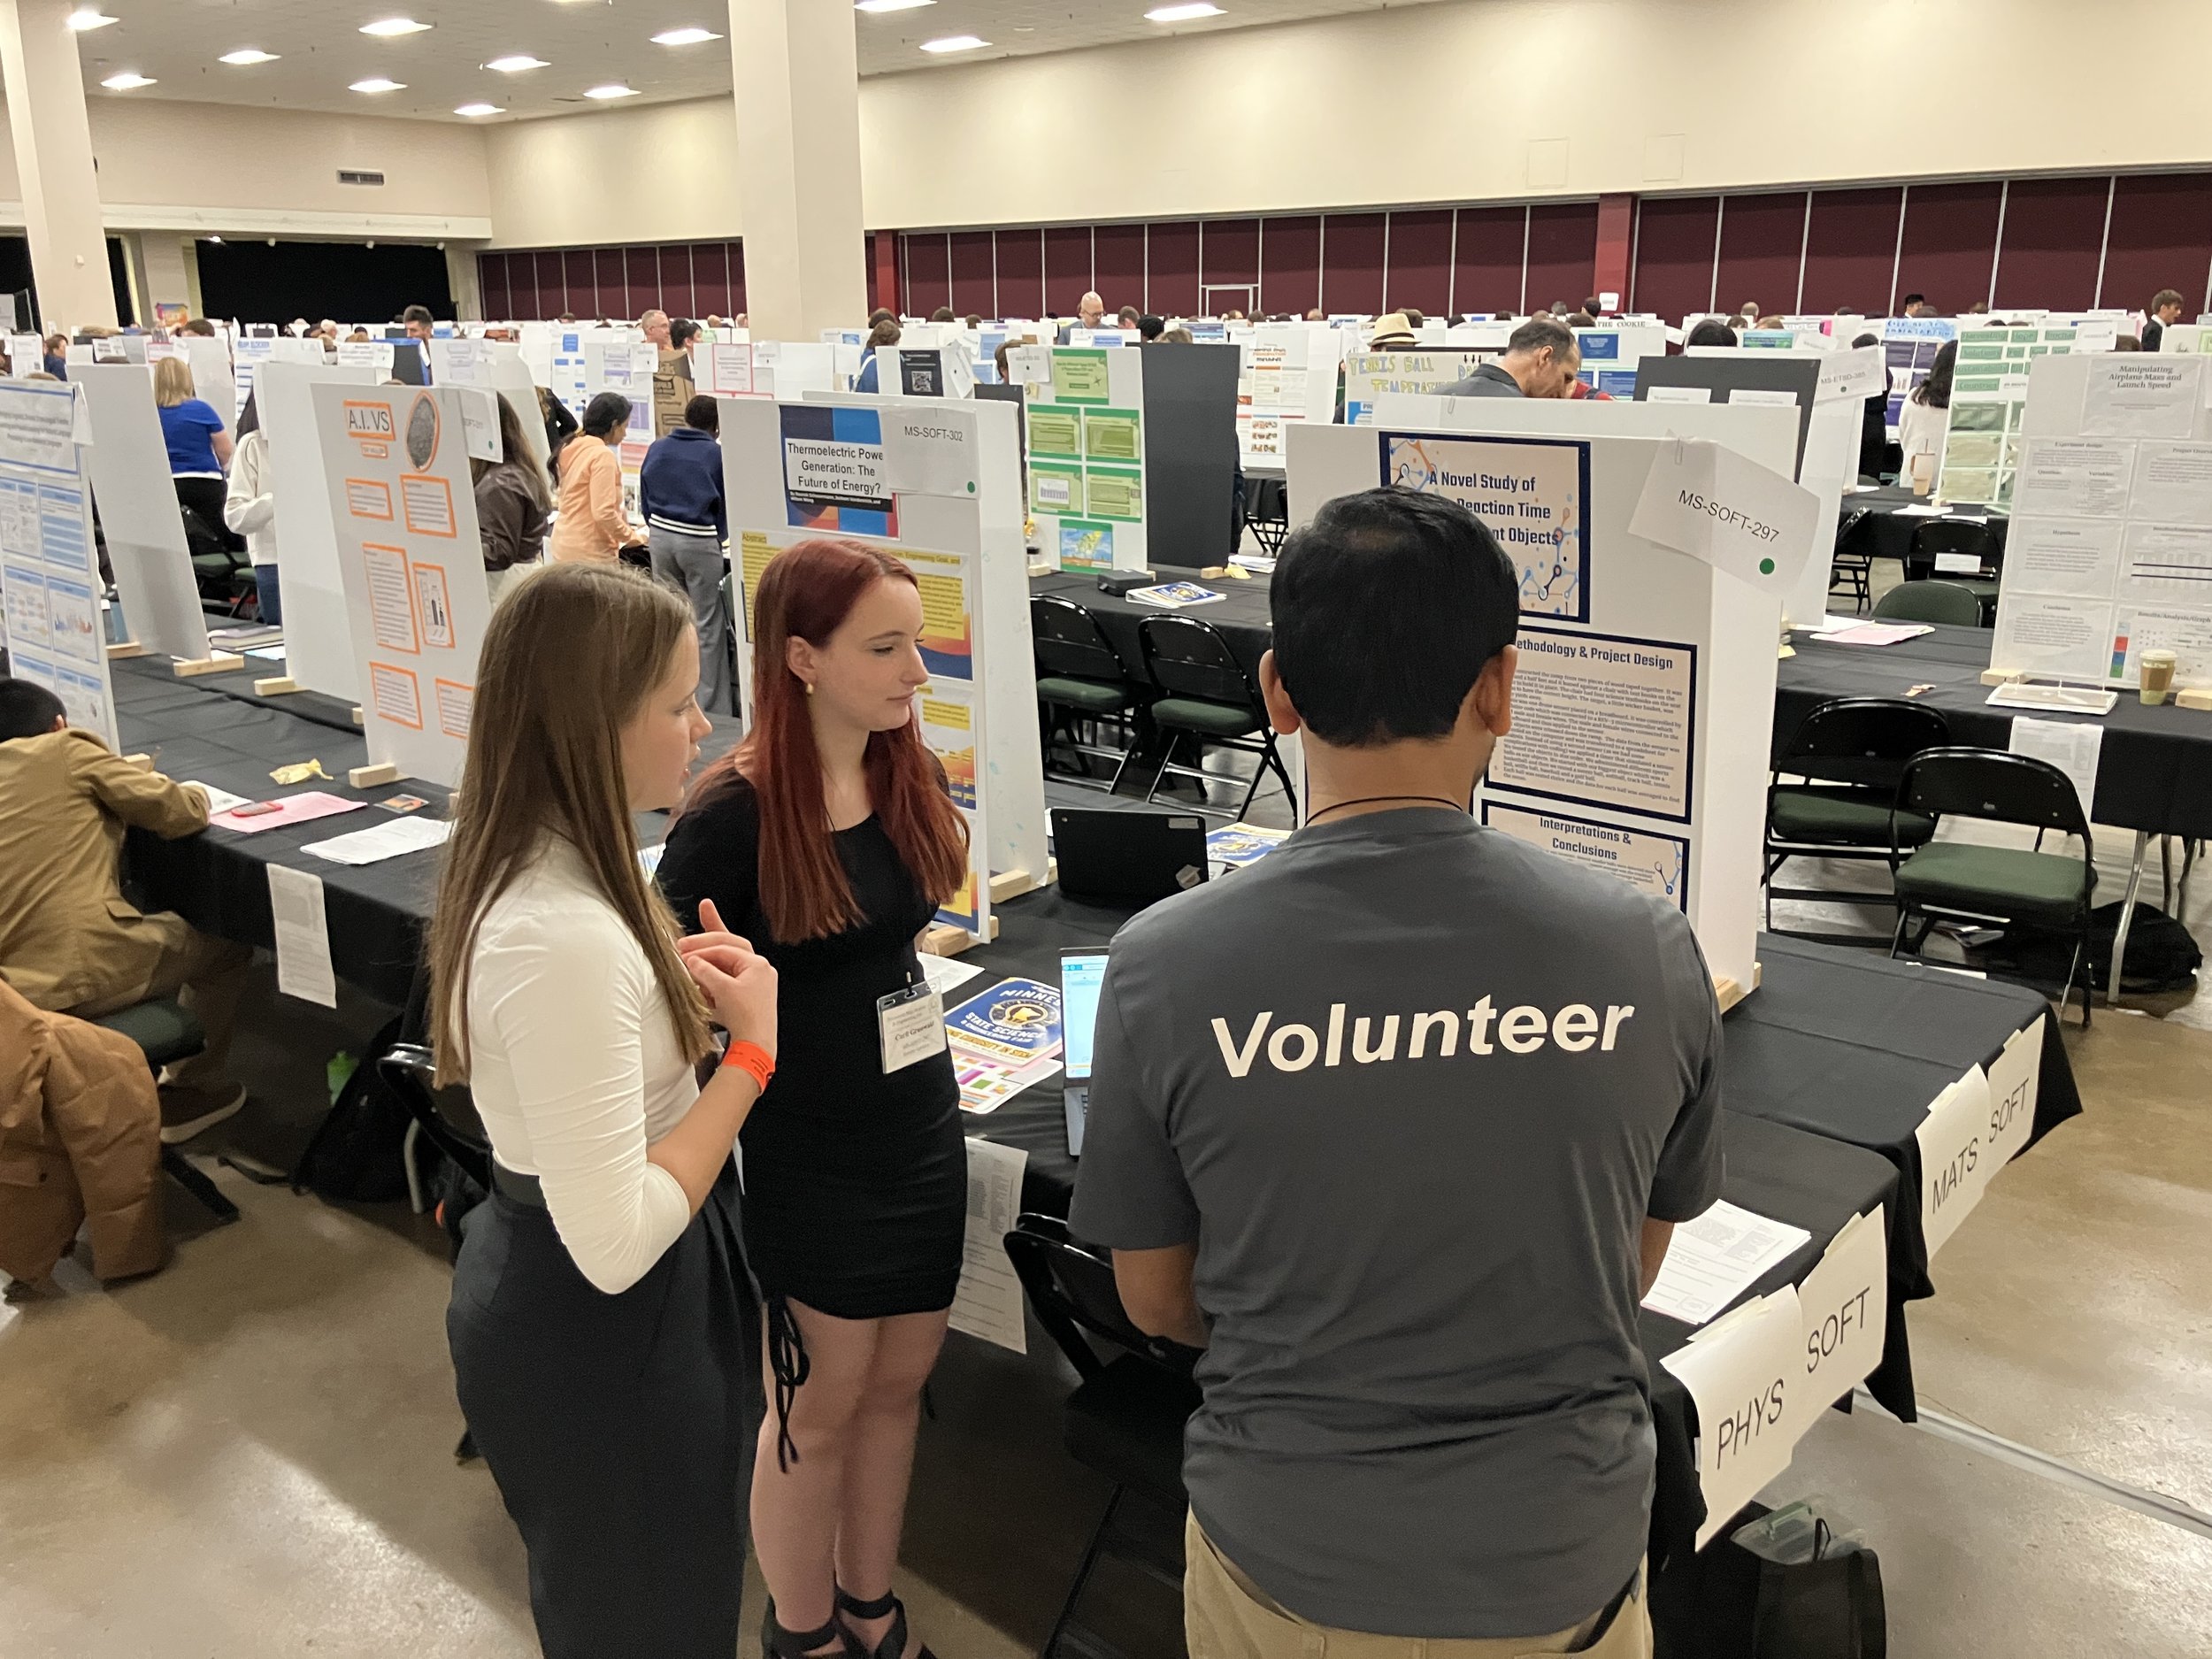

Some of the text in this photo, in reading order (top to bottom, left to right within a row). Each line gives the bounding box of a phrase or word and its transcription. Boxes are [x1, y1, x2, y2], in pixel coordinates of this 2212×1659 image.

[1349, 355, 1434, 375] TENNIS BALL
[2119, 365, 2173, 374] Manipulating
[1371, 379, 1440, 395] TEMPERAT
[349, 410, 390, 432] A.I. VS
[904, 426, 963, 442] MS-SOFT-302
[787, 443, 883, 460] Thermoelectric Powe
[802, 461, 875, 476] Generation: The
[798, 476, 881, 495] Future of Energy?
[1428, 472, 1536, 492] A Novel Study of
[1518, 502, 1551, 518] Time
[1678, 490, 1780, 543] MS-SOFT-297
[1509, 527, 1559, 546] Objects
[1517, 640, 1673, 670] ethodology & Project Design
[1540, 817, 1632, 845] Interpretations &
[1553, 838, 1617, 860] Conclusions
[1000, 990, 1062, 1007] MINNES
[965, 1011, 993, 1032] STATE
[1210, 994, 1635, 1078] Volunteer
[1932, 1078, 2029, 1214] MATS SOFT
[1717, 1286, 1870, 1470] PHYS SOFT
